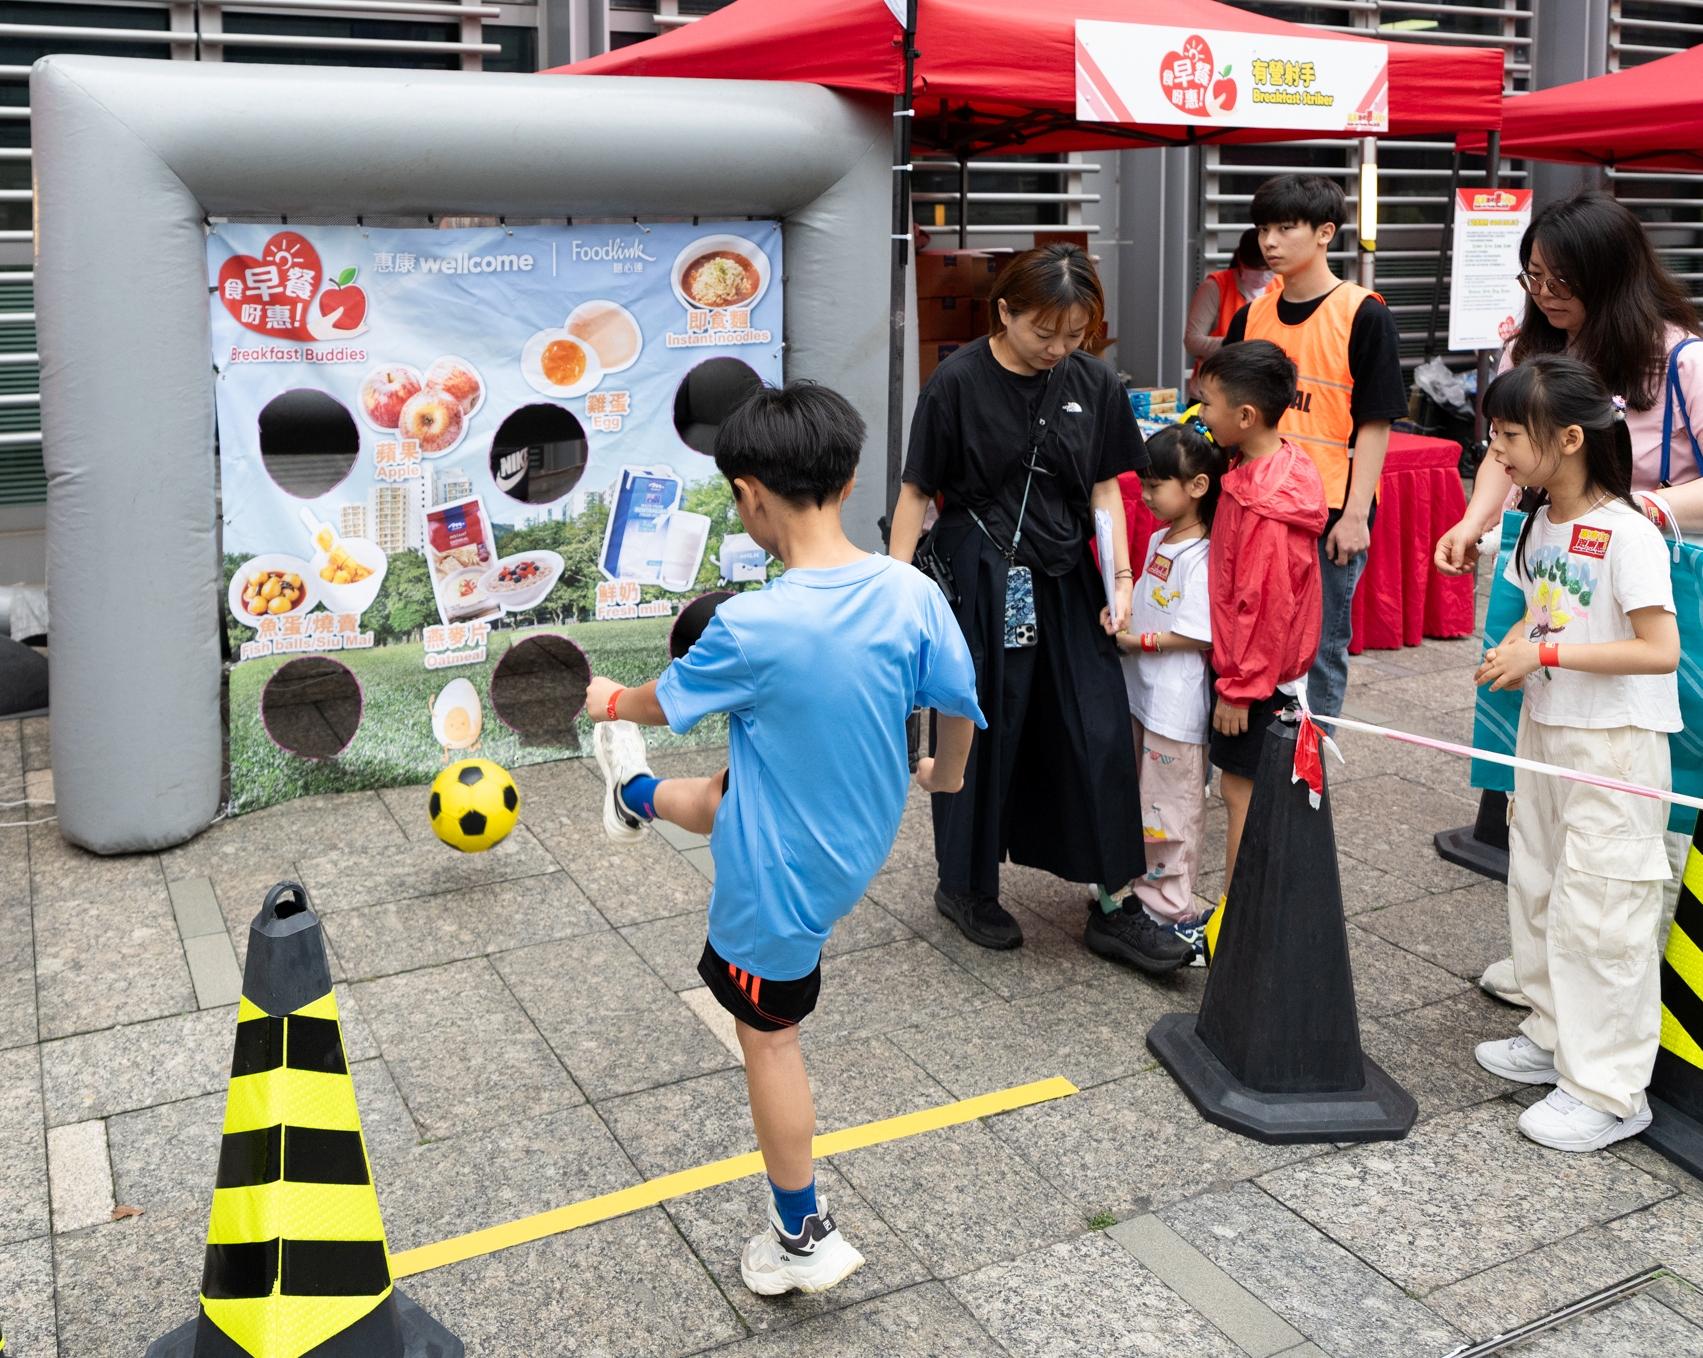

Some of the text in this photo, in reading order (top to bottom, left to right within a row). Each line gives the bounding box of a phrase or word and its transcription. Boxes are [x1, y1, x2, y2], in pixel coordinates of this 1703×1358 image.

[1252, 87, 1301, 105] Breakfast
[572, 238, 656, 262] Foodlink
[374, 252, 534, 274] 惠康 wellcome
[224, 264, 316, 301] 食早餐
[667, 330, 769, 346] Instant noodles
[231, 345, 366, 362] Breakfast Buddies
[594, 416, 620, 430] Egg
[375, 442, 420, 464] 蘋果
[376, 465, 421, 480] Apple
[598, 583, 639, 603] 鮮奶
[598, 601, 670, 617] Fresh milk
[242, 642, 270, 658] Fish
[345, 632, 372, 647] Mai
[426, 649, 486, 667] Oatmeal
